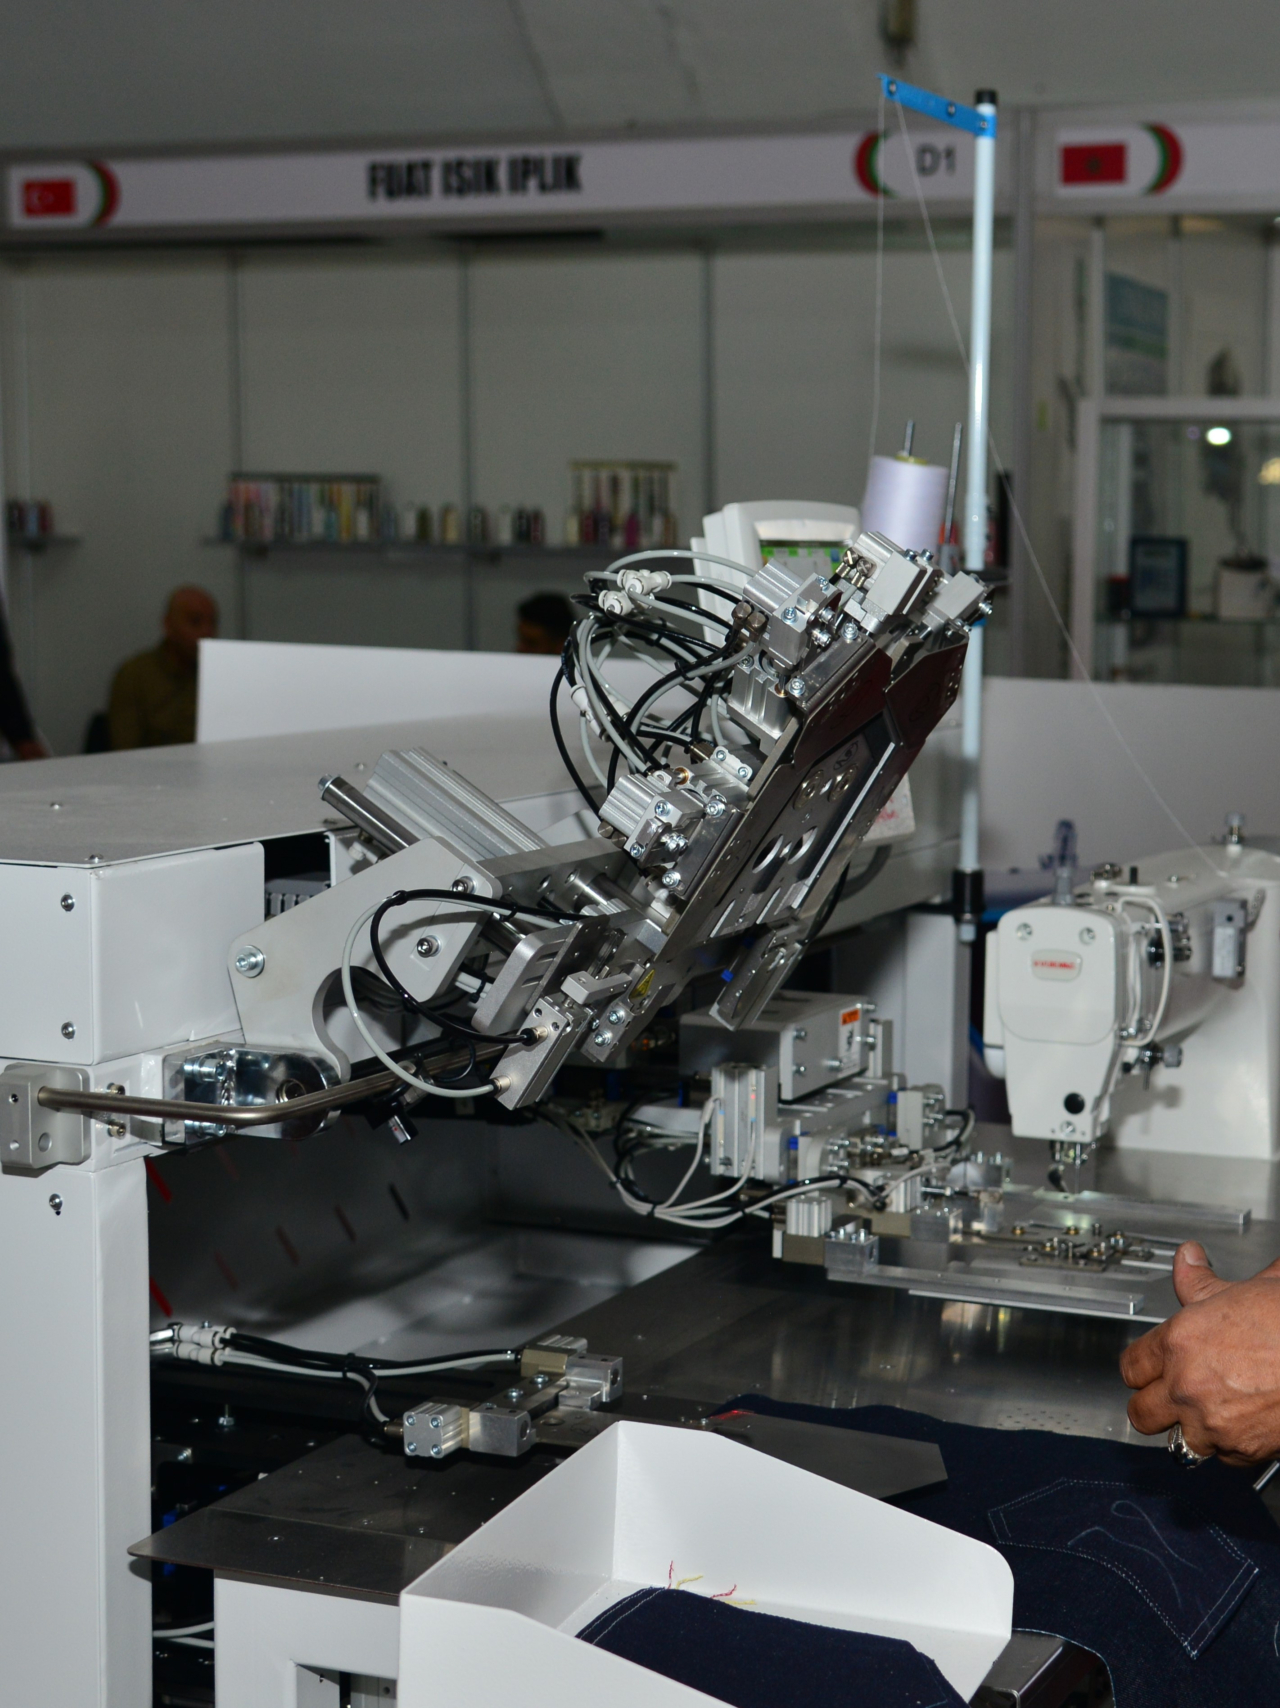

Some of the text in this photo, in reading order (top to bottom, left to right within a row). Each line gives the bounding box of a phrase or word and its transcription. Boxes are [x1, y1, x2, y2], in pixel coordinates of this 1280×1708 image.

[368, 153, 582, 200] FUAT ISIK IPLIK
[916, 143, 956, 177] D1
